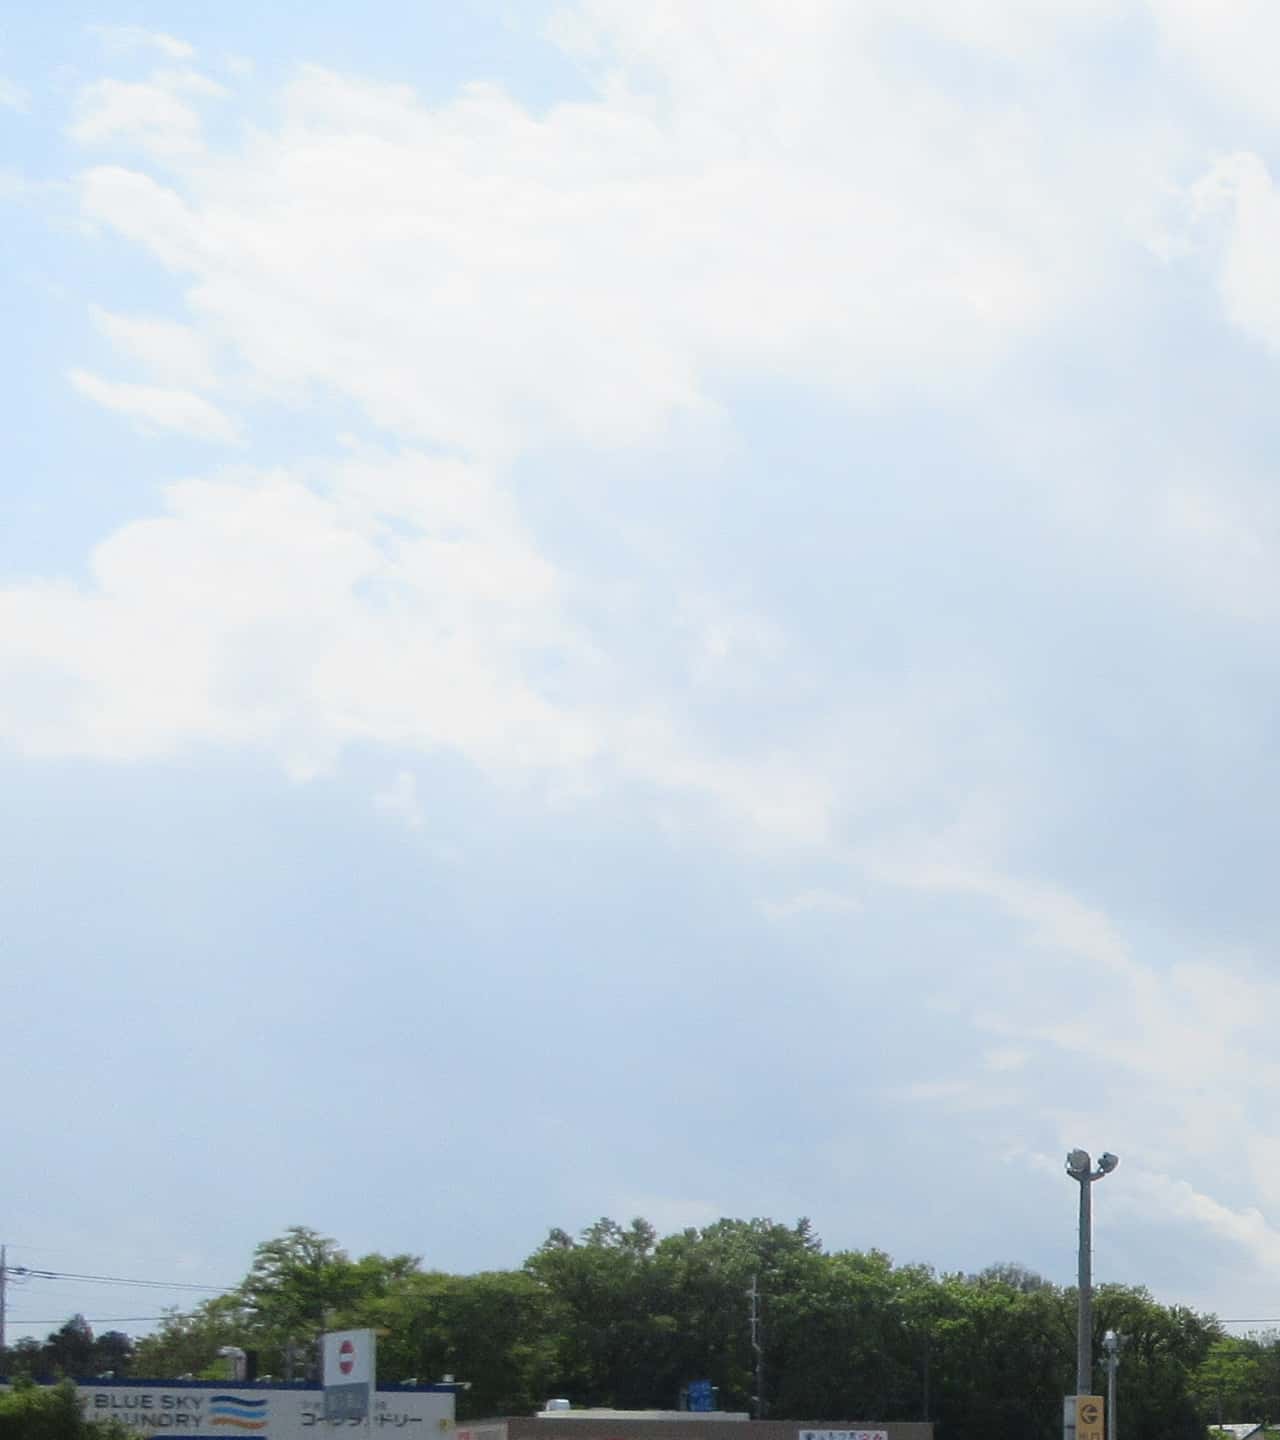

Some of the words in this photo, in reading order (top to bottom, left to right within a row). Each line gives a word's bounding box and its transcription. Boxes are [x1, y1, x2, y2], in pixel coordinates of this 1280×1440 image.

[94, 1393, 152, 1409] BLUE
[160, 1394, 204, 1410] SKY
[95, 1411, 203, 1428] AUNDRY
